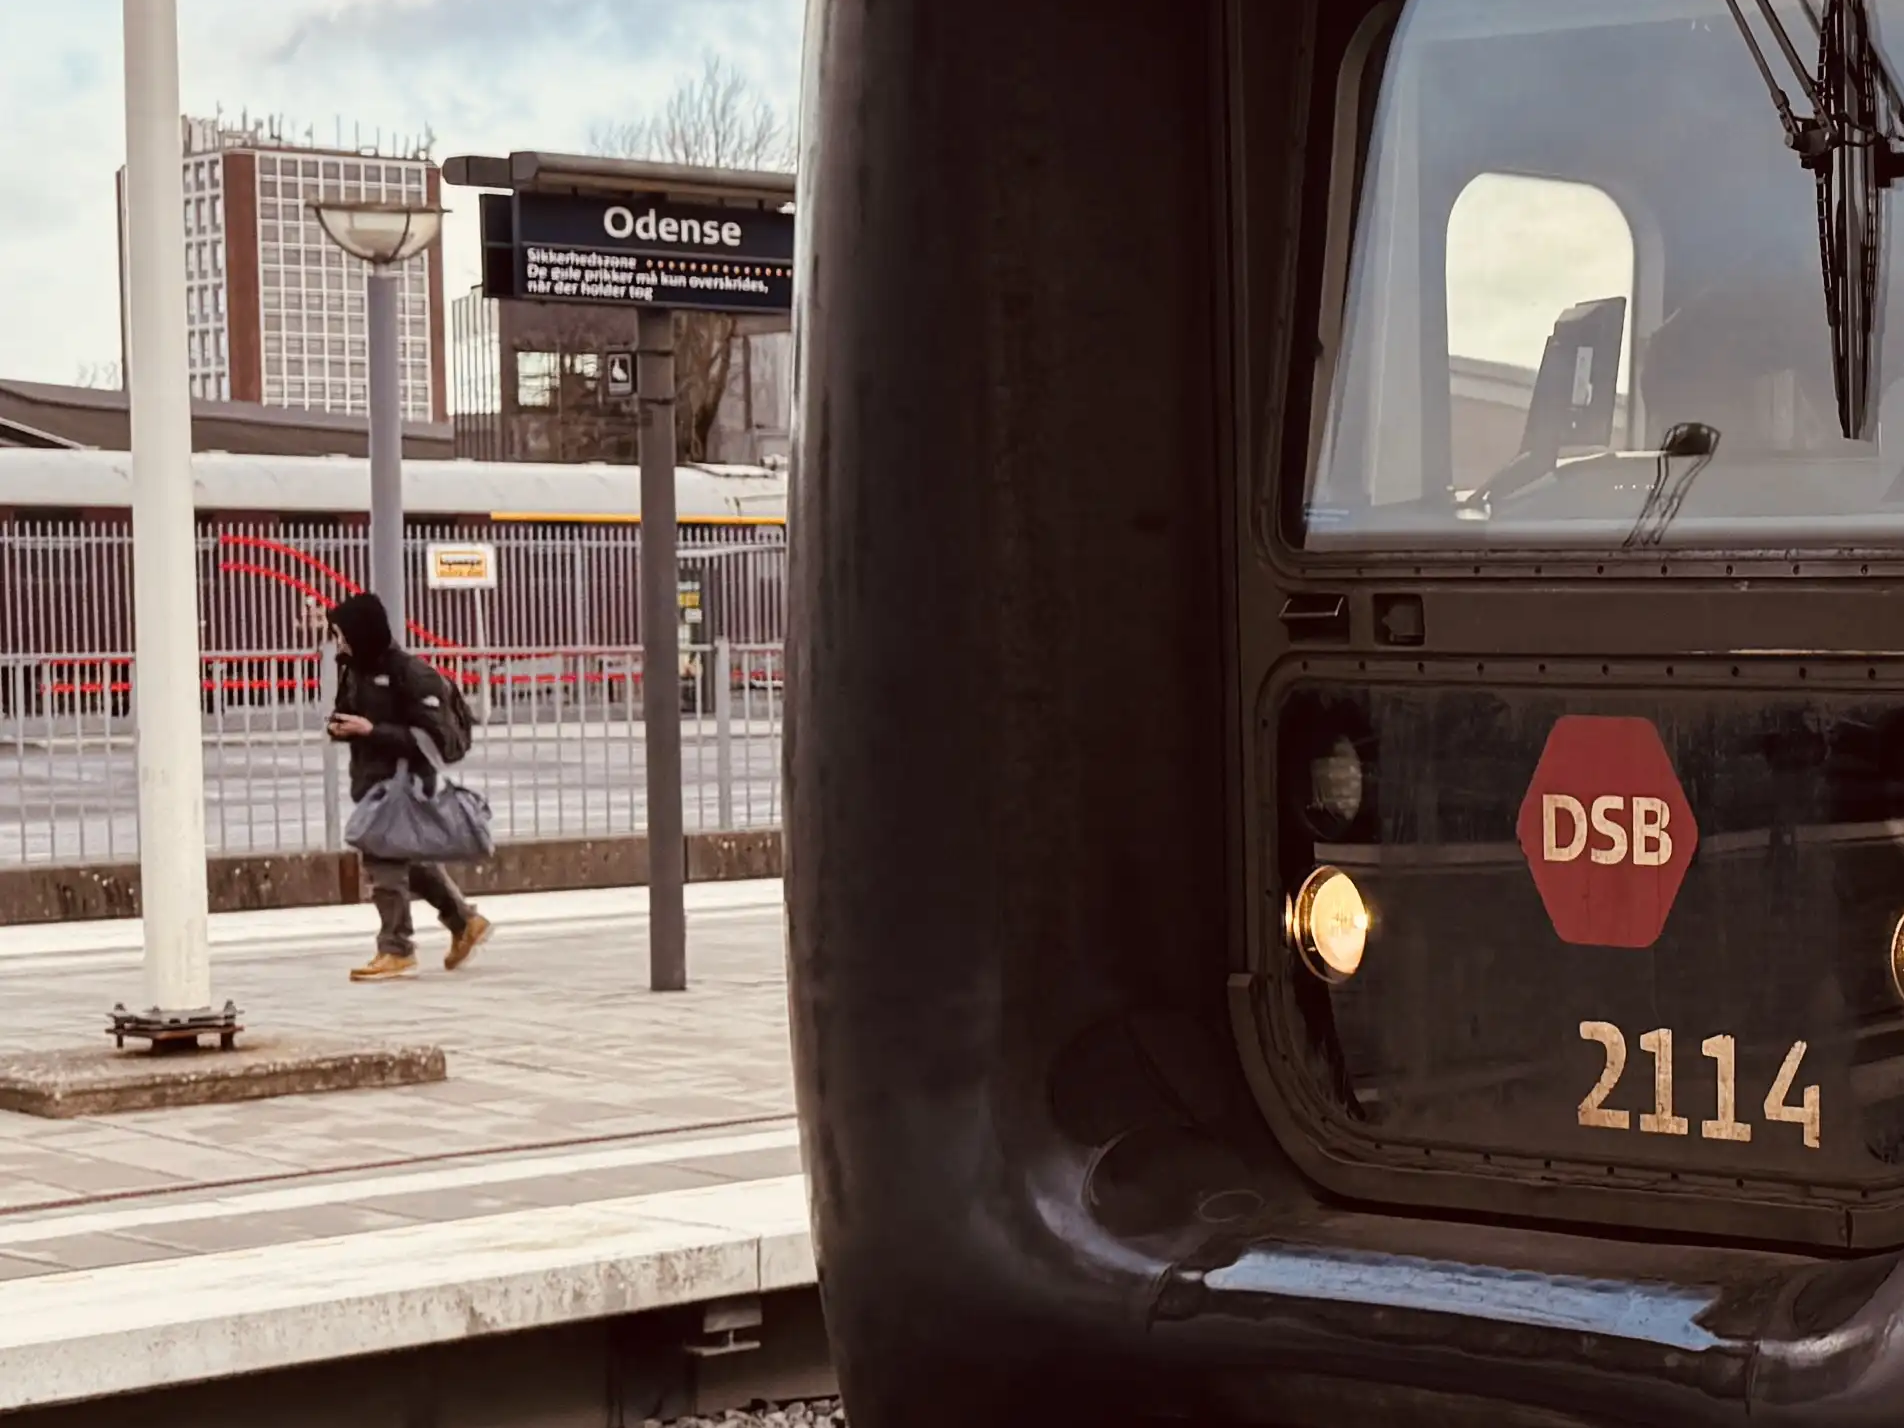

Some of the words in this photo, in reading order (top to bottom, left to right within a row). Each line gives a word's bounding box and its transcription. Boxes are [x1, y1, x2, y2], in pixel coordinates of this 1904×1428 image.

[603, 205, 742, 246] Odense
[526, 262, 548, 279] De
[661, 271, 687, 288] kun
[554, 280, 579, 295] der
[580, 280, 627, 298] holder
[628, 284, 653, 302] tog
[1542, 794, 1673, 865] DSB
[1577, 1021, 1820, 1148] 2114
